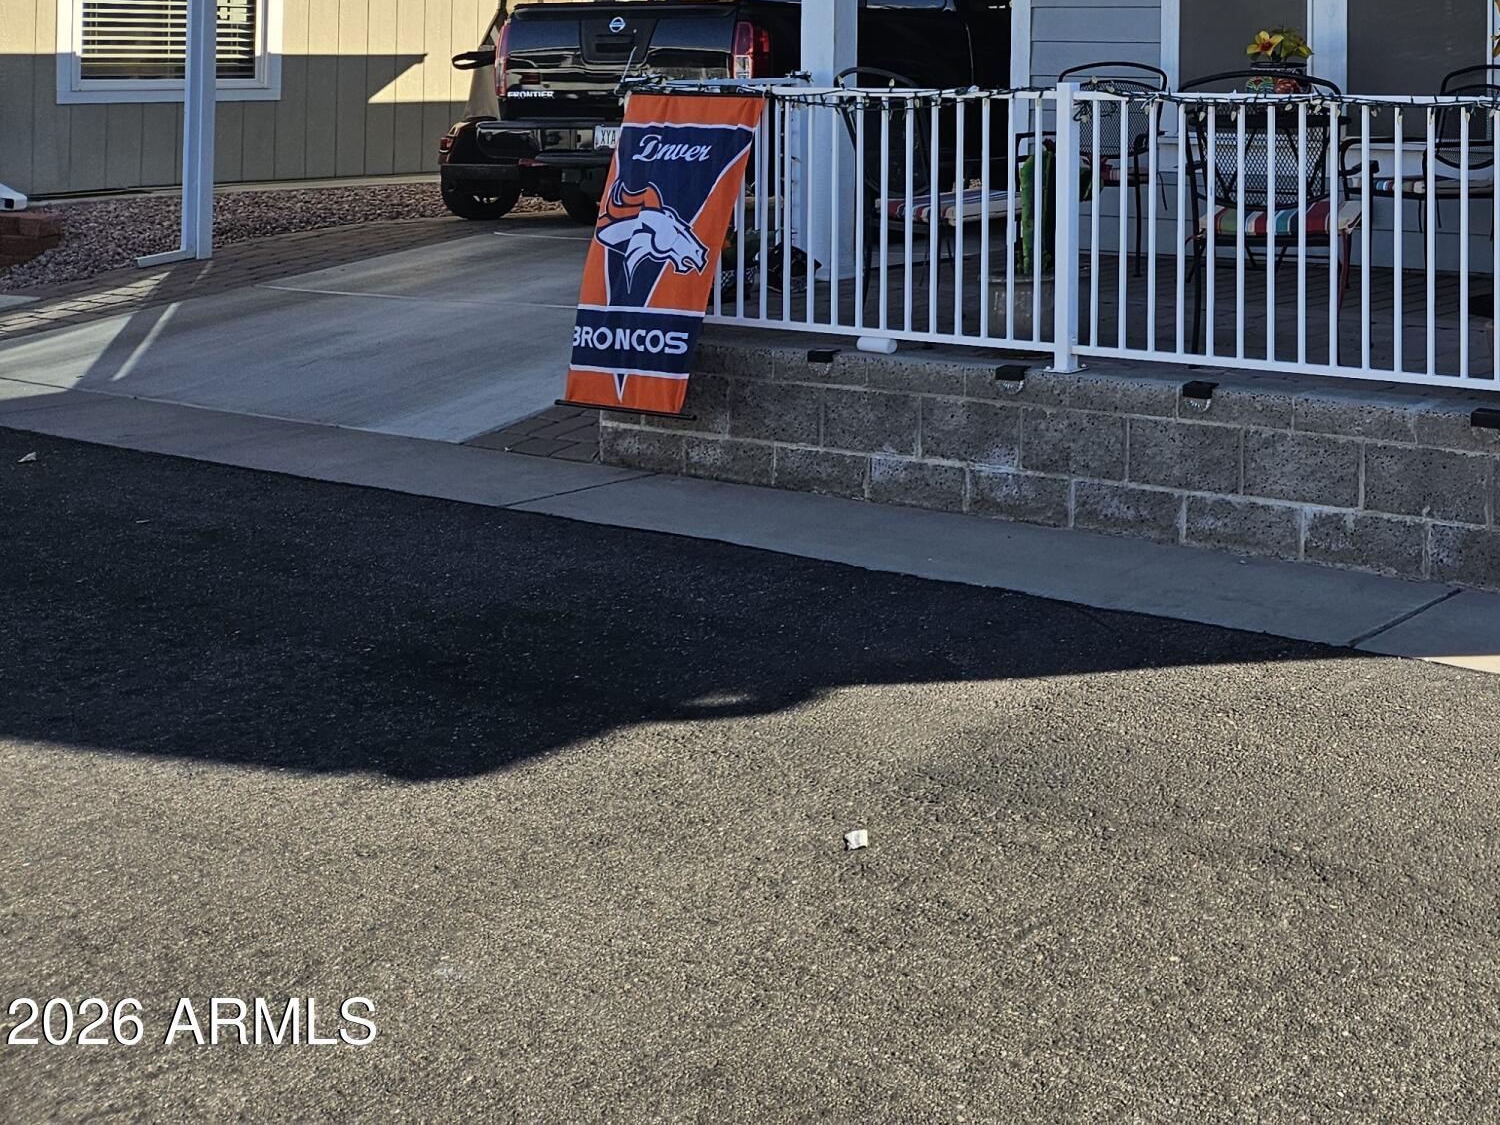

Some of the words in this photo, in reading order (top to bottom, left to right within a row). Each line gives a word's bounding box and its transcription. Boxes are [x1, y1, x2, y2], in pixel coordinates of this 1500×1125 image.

[508, 91, 554, 99] FRONTIER
[632, 134, 712, 162] Dnver
[572, 325, 689, 355] BRONCOS
